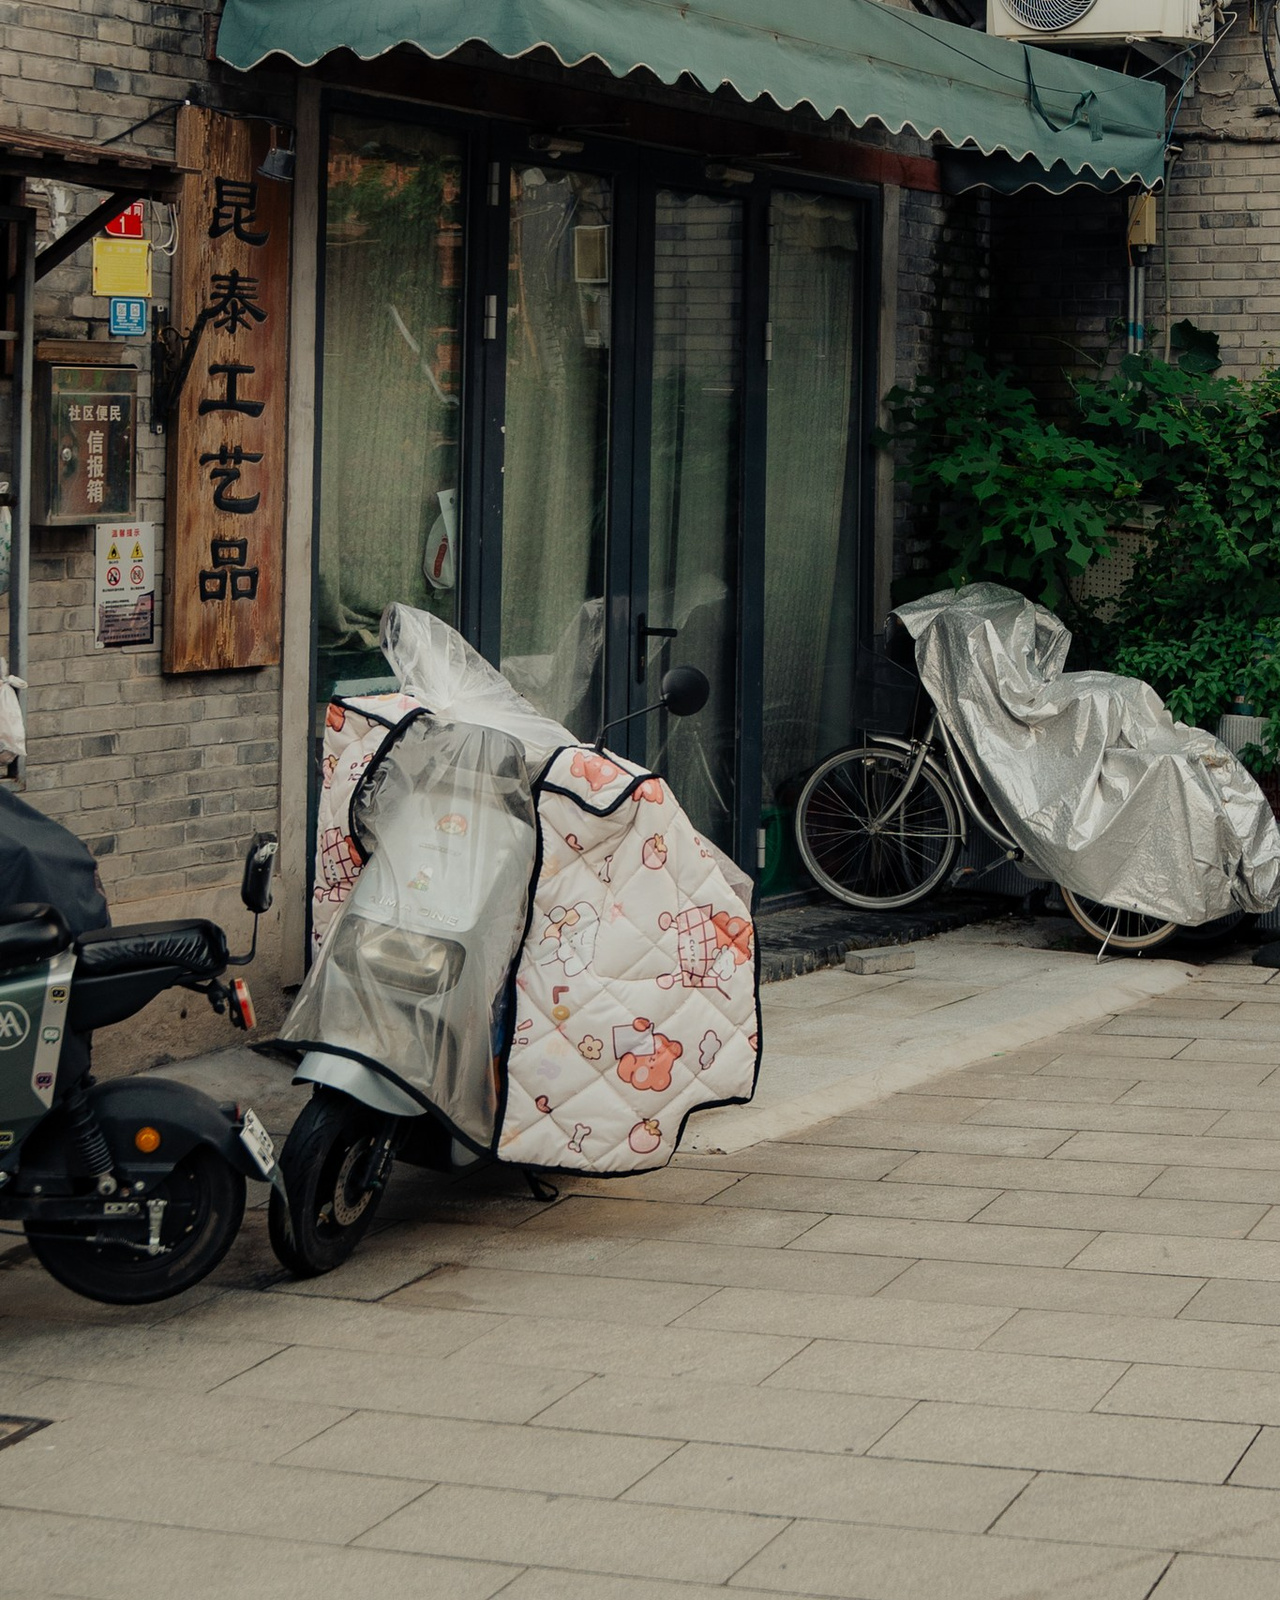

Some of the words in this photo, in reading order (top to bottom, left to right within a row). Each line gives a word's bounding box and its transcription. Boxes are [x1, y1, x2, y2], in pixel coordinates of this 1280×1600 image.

[119, 215, 126, 234] 1
[197, 174, 271, 602] 昆泰工艺品
[68, 404, 122, 422] 社区便民
[87, 430, 105, 504] 信报箱
[420, 907, 459, 927] ONE
[689, 938, 697, 964] CUTE
